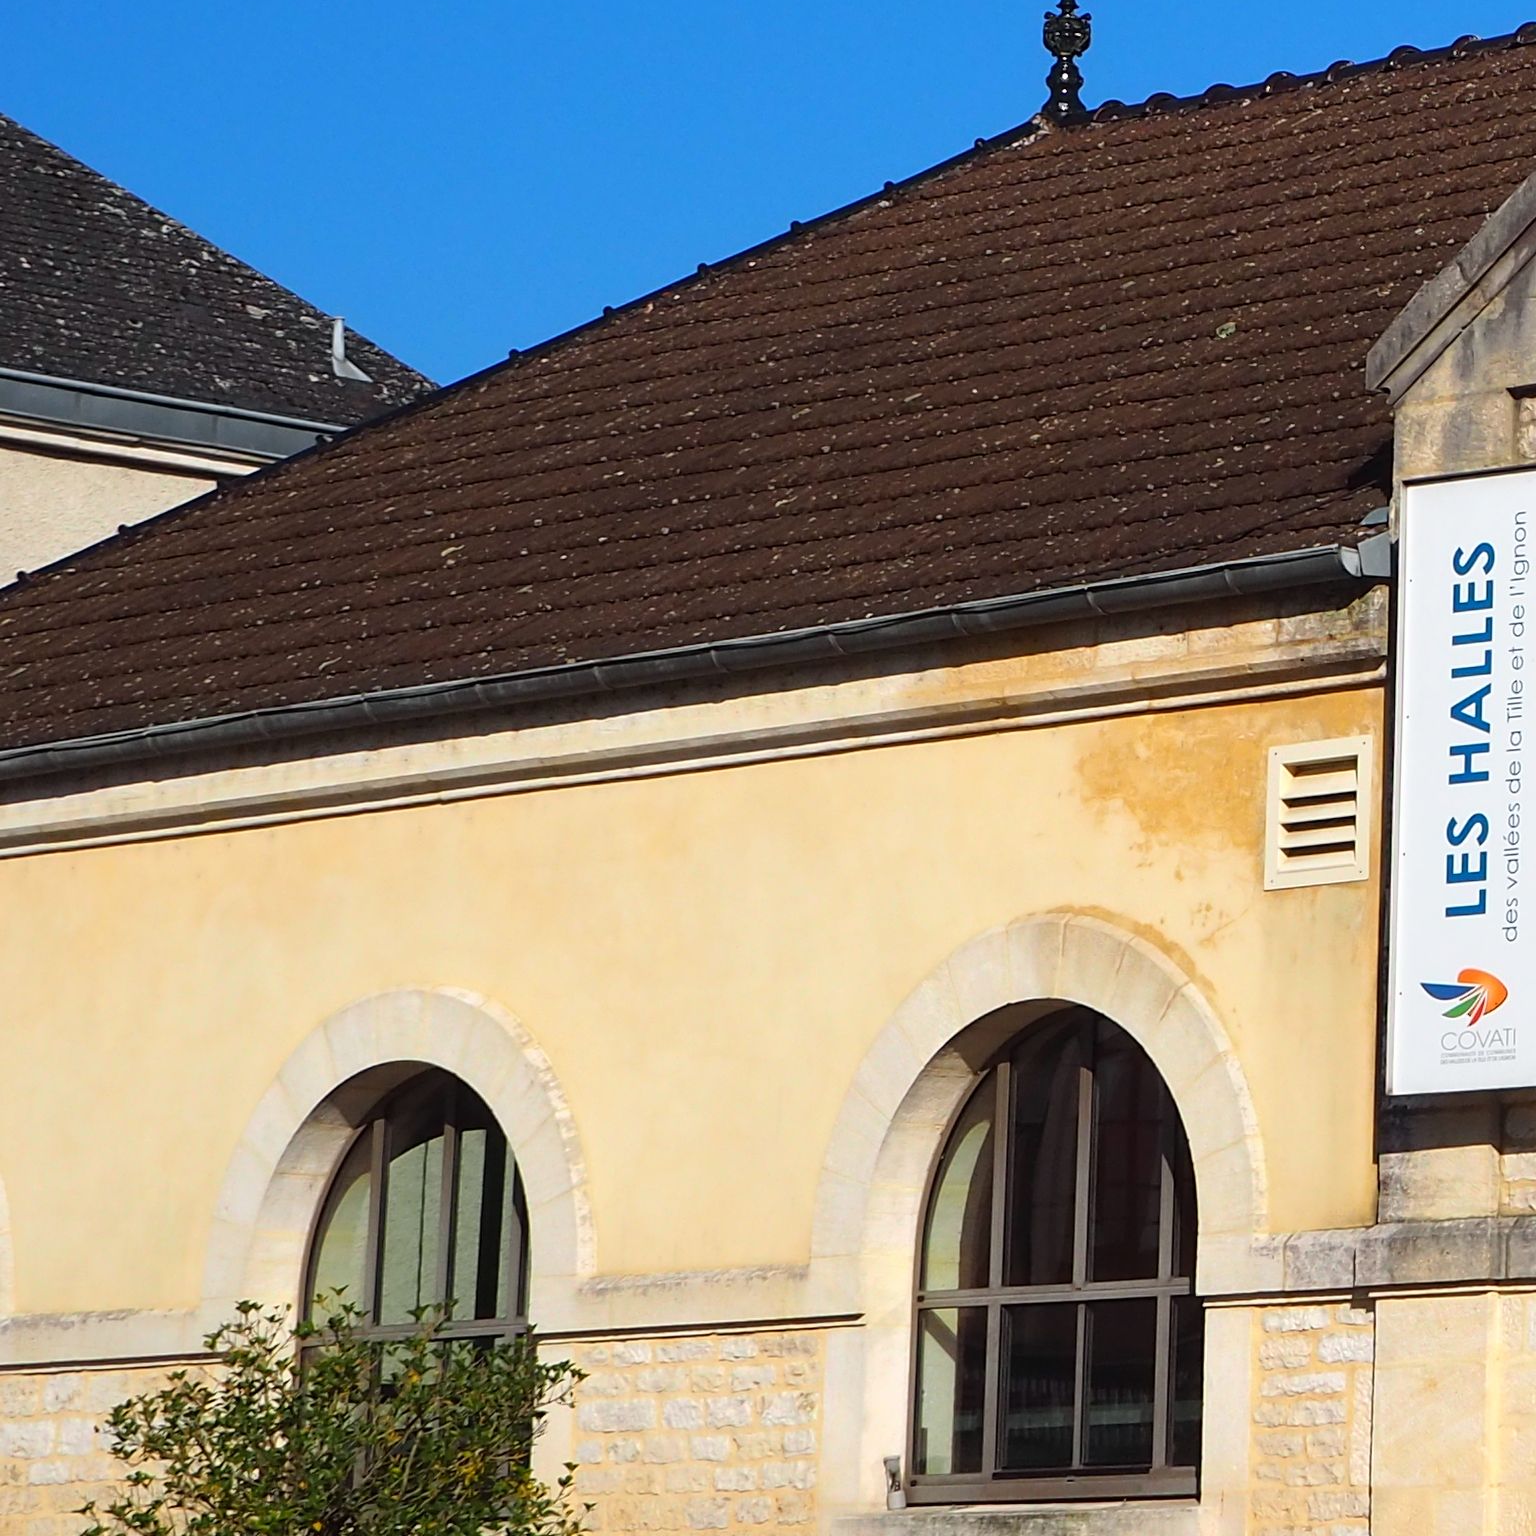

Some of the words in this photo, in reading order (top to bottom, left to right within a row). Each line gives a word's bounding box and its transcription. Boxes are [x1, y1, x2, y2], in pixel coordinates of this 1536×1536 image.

[1509, 511, 1530, 597] l'Ignon
[1508, 604, 1526, 638] de
[1447, 541, 1496, 786] HALLES
[1508, 647, 1524, 671] et
[1506, 679, 1524, 723] Tille
[1505, 730, 1523, 753] la
[1504, 760, 1522, 794] de
[1444, 812, 1490, 918] LES
[1502, 802, 1521, 890] vallées
[1501, 897, 1519, 943] des
[1441, 1027, 1516, 1051] COVATI
